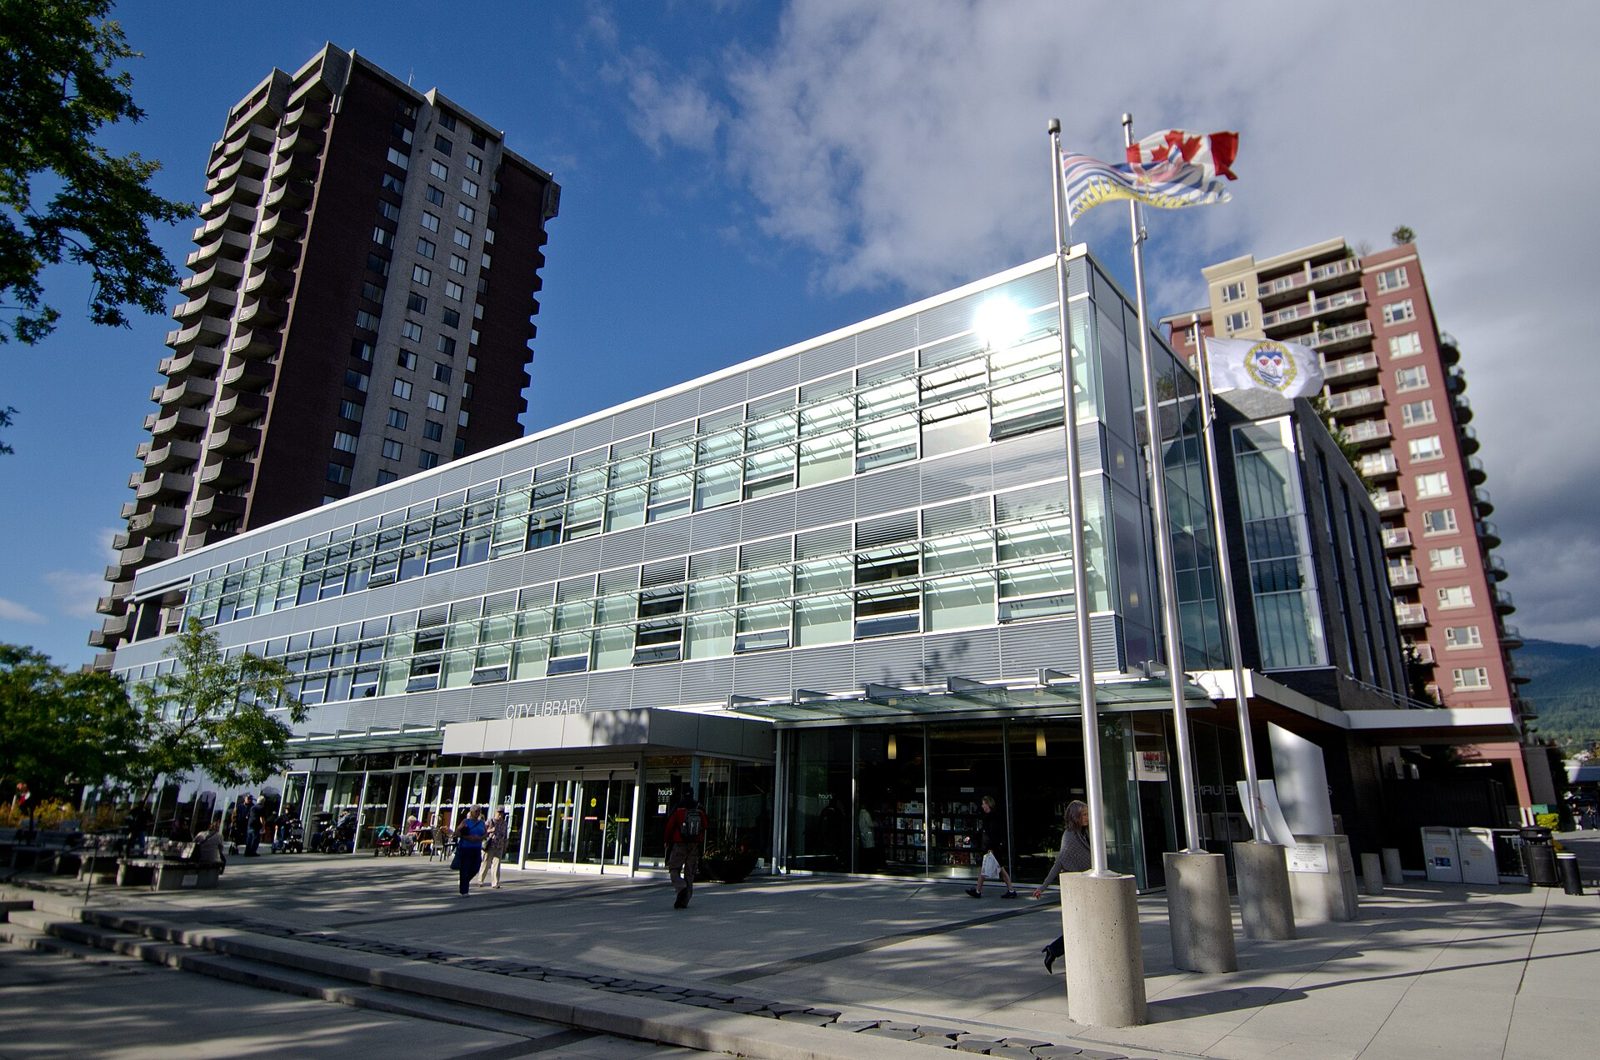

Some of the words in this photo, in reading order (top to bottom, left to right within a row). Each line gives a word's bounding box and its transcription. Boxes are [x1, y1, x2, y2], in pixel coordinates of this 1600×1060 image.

[505, 703, 532, 720] CITY
[534, 697, 586, 717] LIBRARY
[657, 788, 673, 796] hours
